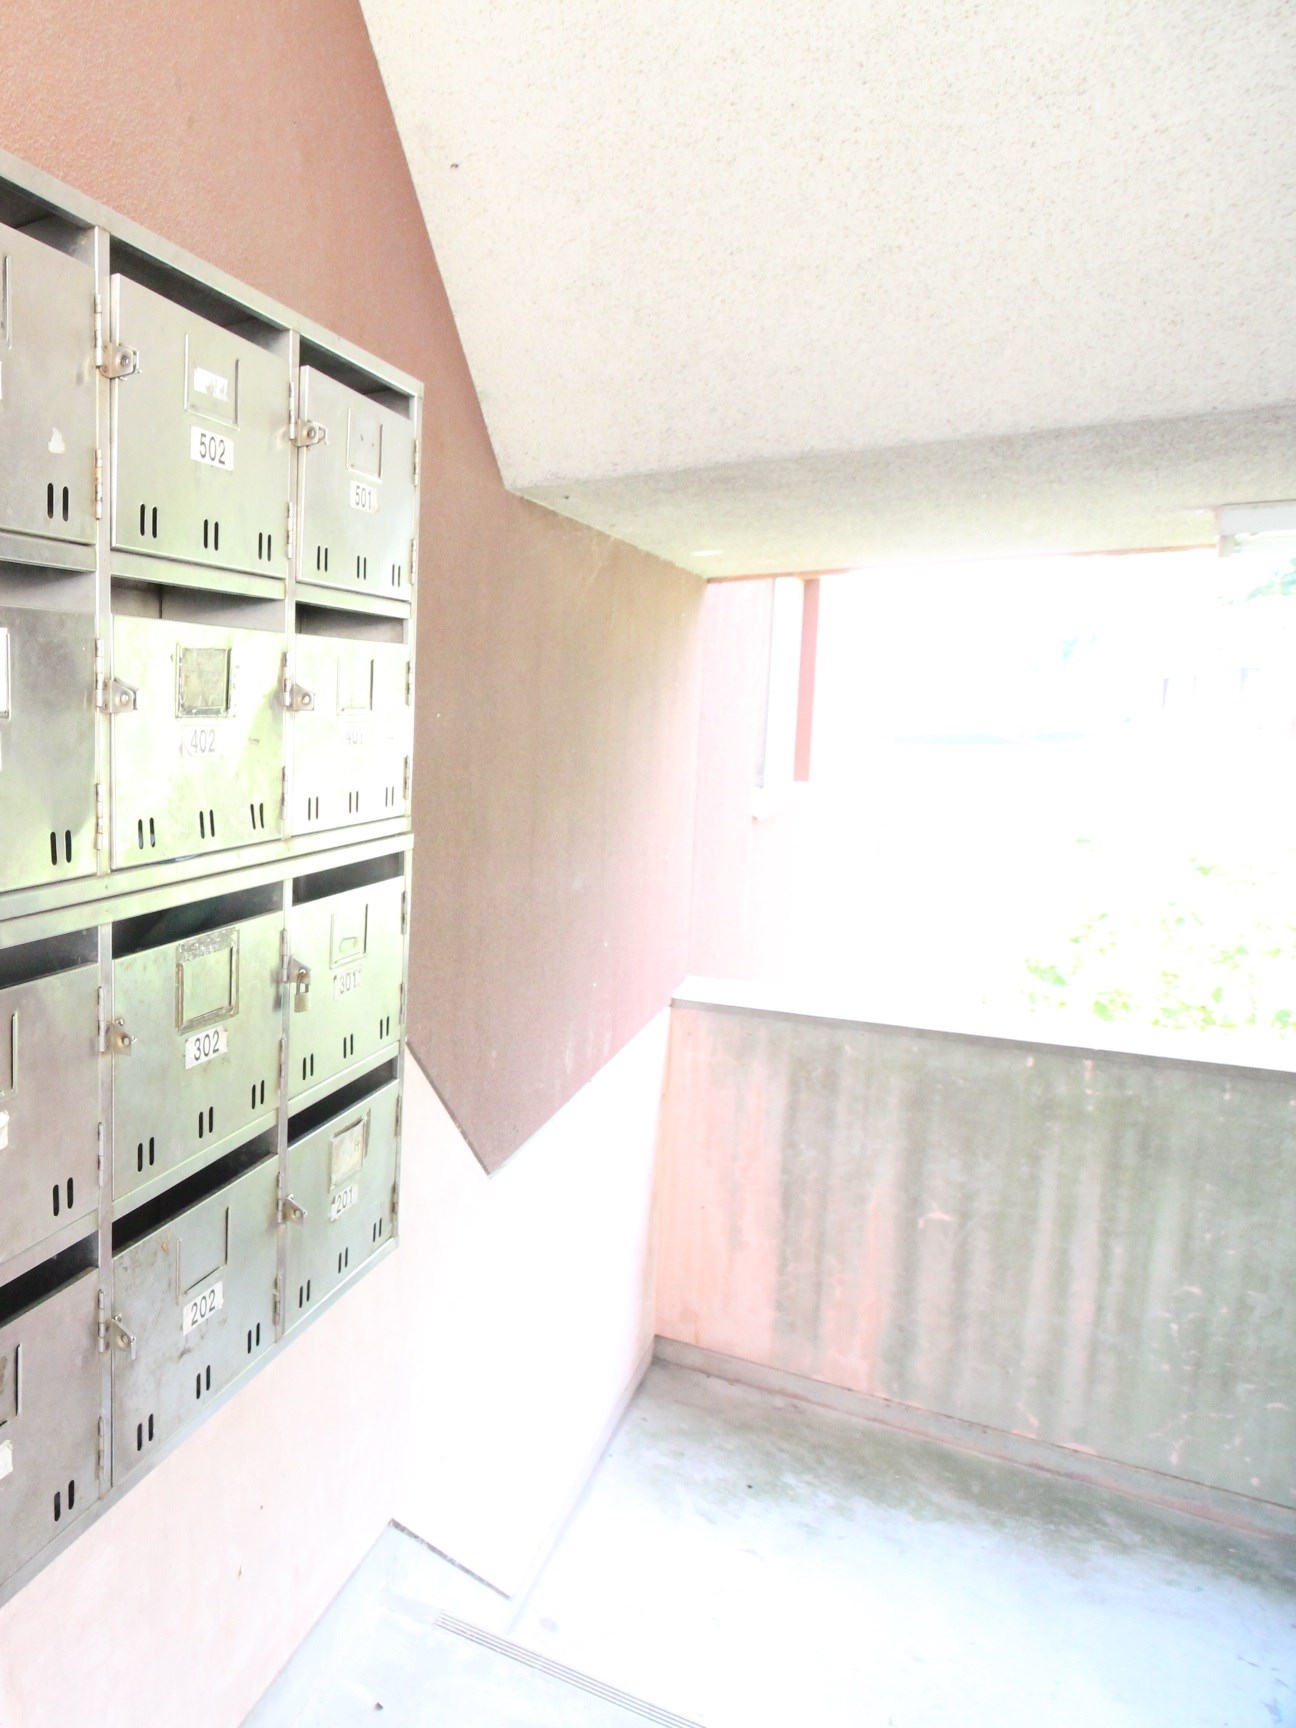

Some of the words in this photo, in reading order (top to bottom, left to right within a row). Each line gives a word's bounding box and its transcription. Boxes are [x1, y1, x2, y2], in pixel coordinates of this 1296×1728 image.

[199, 432, 226, 466] 502
[355, 485, 373, 509] 501
[190, 729, 216, 753] 402
[339, 973, 357, 995] 301
[193, 1031, 220, 1061] 302
[335, 1187, 353, 1214] 201
[190, 1289, 216, 1327] 202
